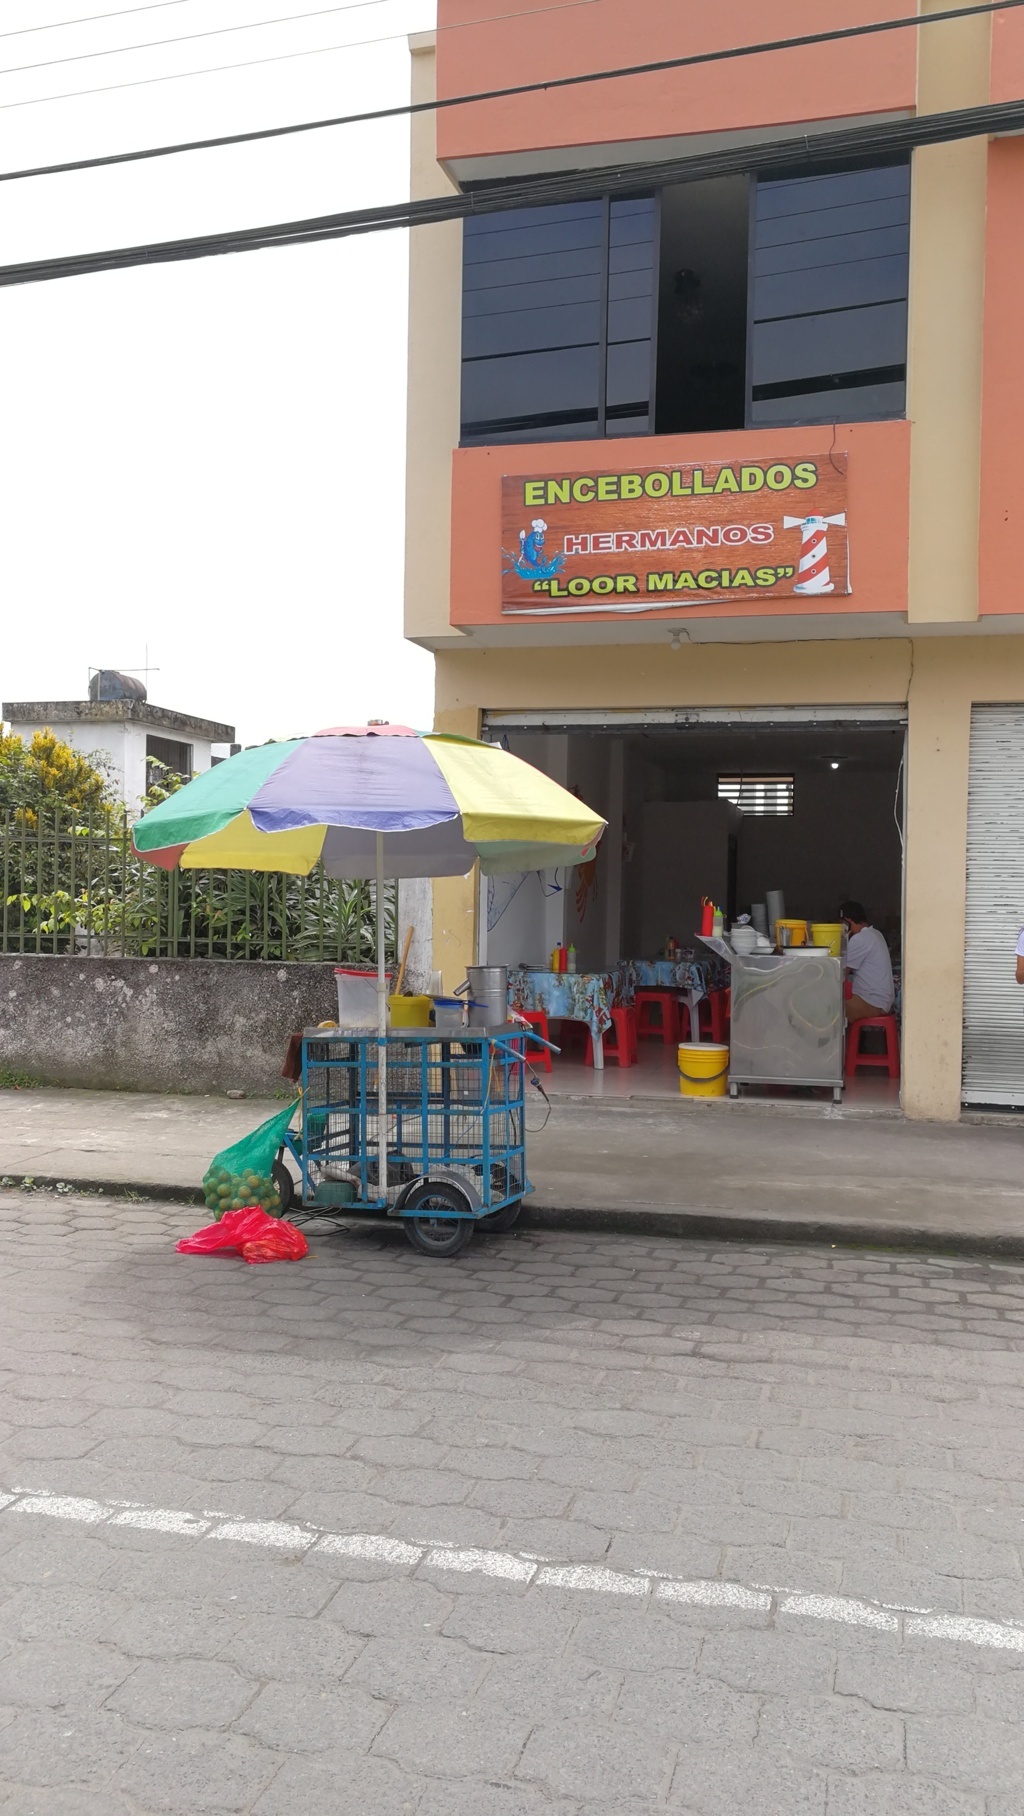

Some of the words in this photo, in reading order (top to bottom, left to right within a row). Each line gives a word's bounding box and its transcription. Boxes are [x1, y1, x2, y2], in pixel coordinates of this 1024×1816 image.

[524, 463, 818, 506] ENCEBOLLADOS
[564, 524, 774, 554] HERMANOS
[533, 574, 638, 598] “LOOR
[647, 567, 795, 593] MACIAS”
